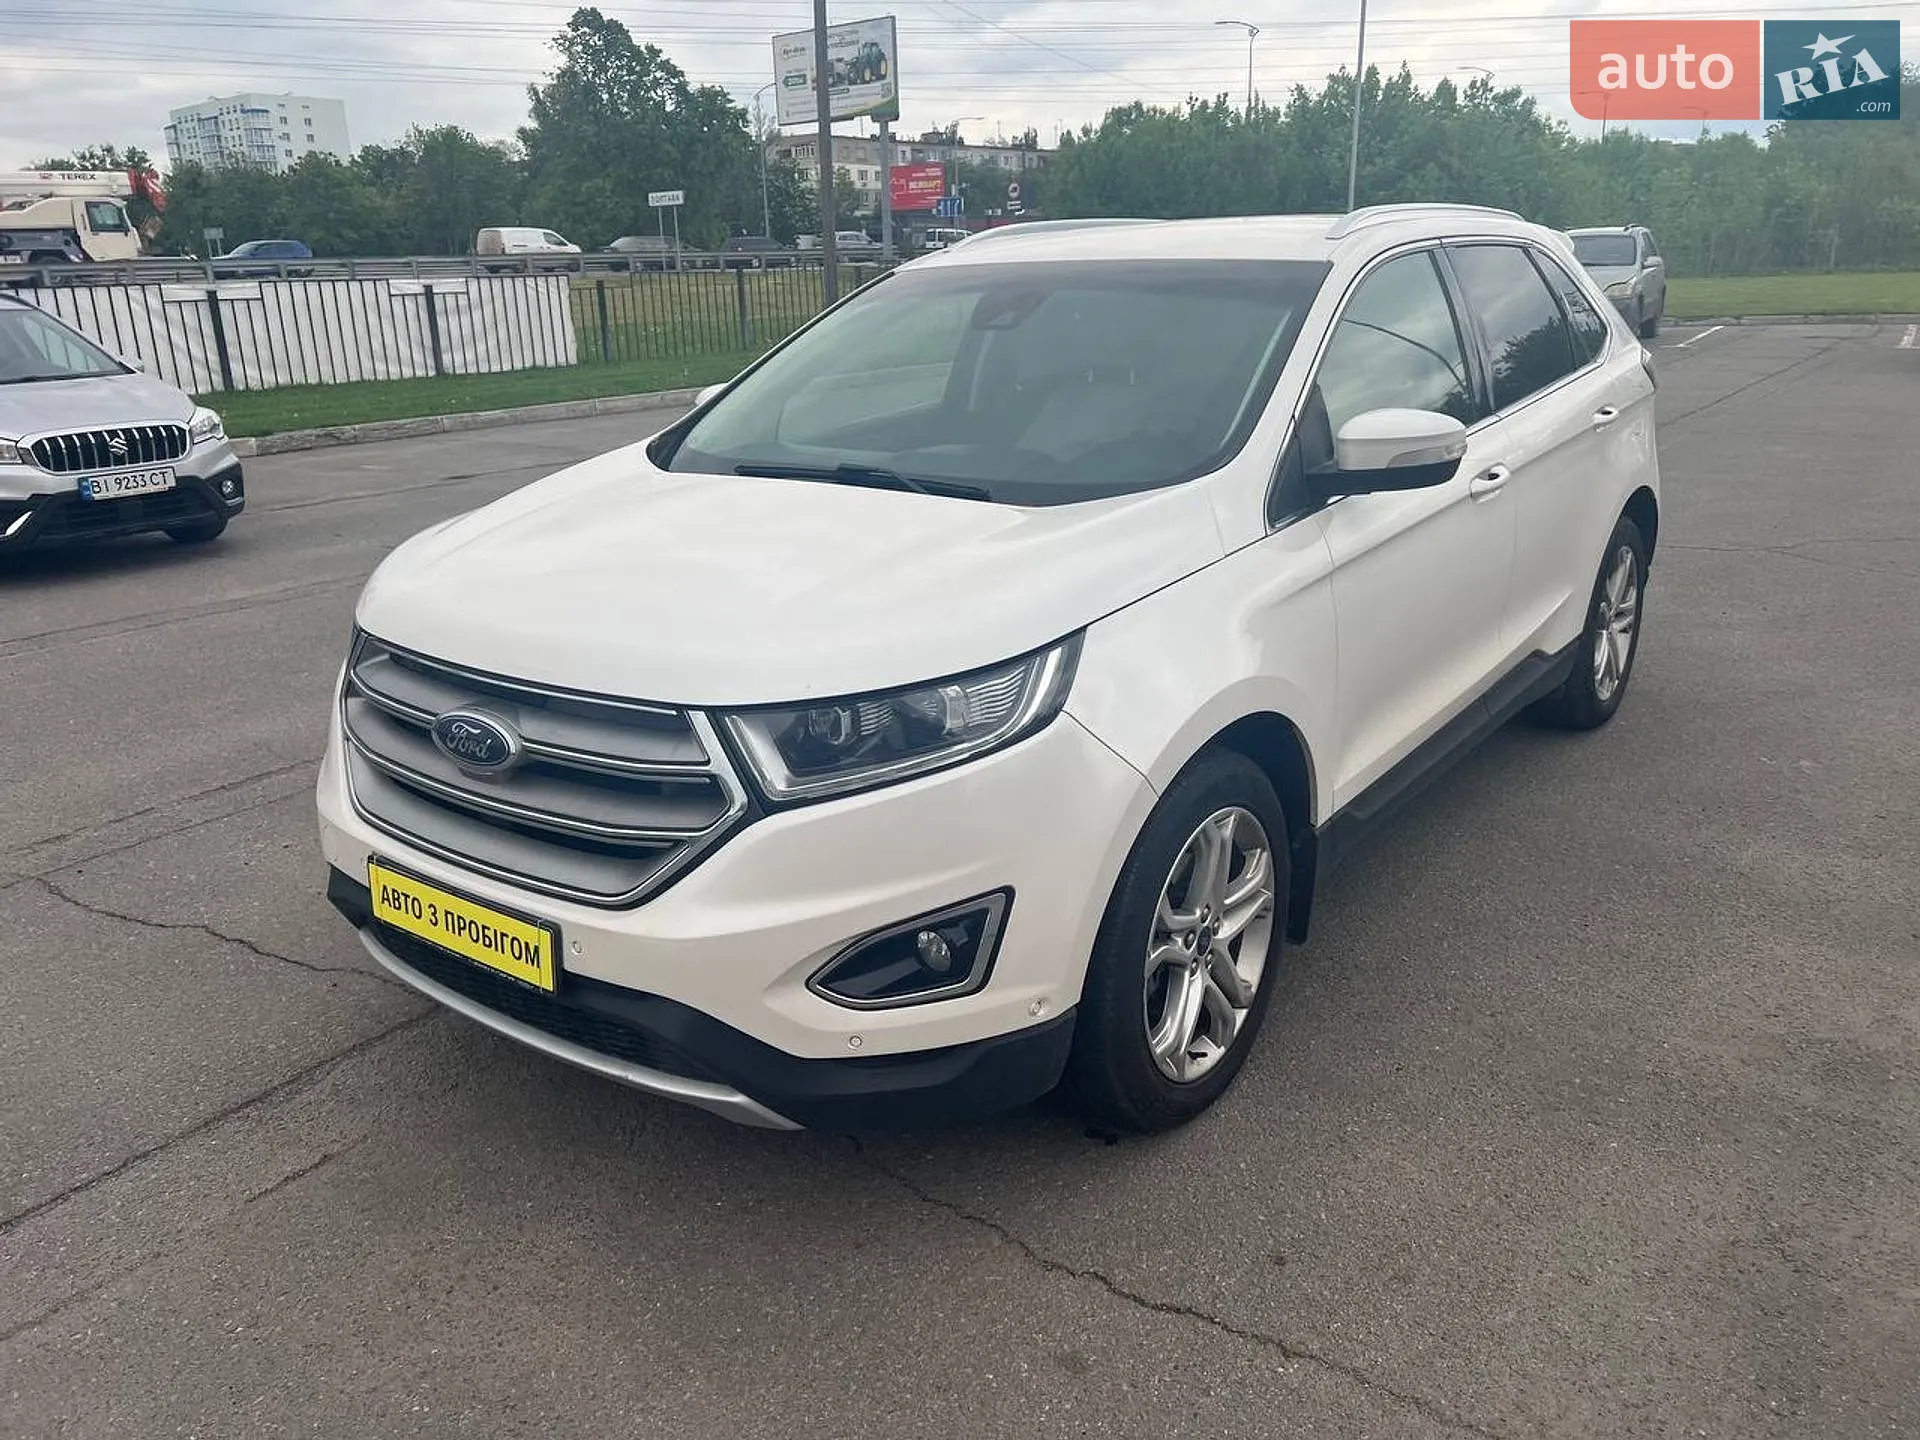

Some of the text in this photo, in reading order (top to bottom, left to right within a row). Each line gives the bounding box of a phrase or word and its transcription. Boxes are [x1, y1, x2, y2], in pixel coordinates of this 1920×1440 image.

[91, 471, 168, 494] BI 9233 CT
[446, 721, 491, 759] Ford
[381, 885, 423, 919] АВТО
[444, 909, 540, 968] ПРОБІГОМ
